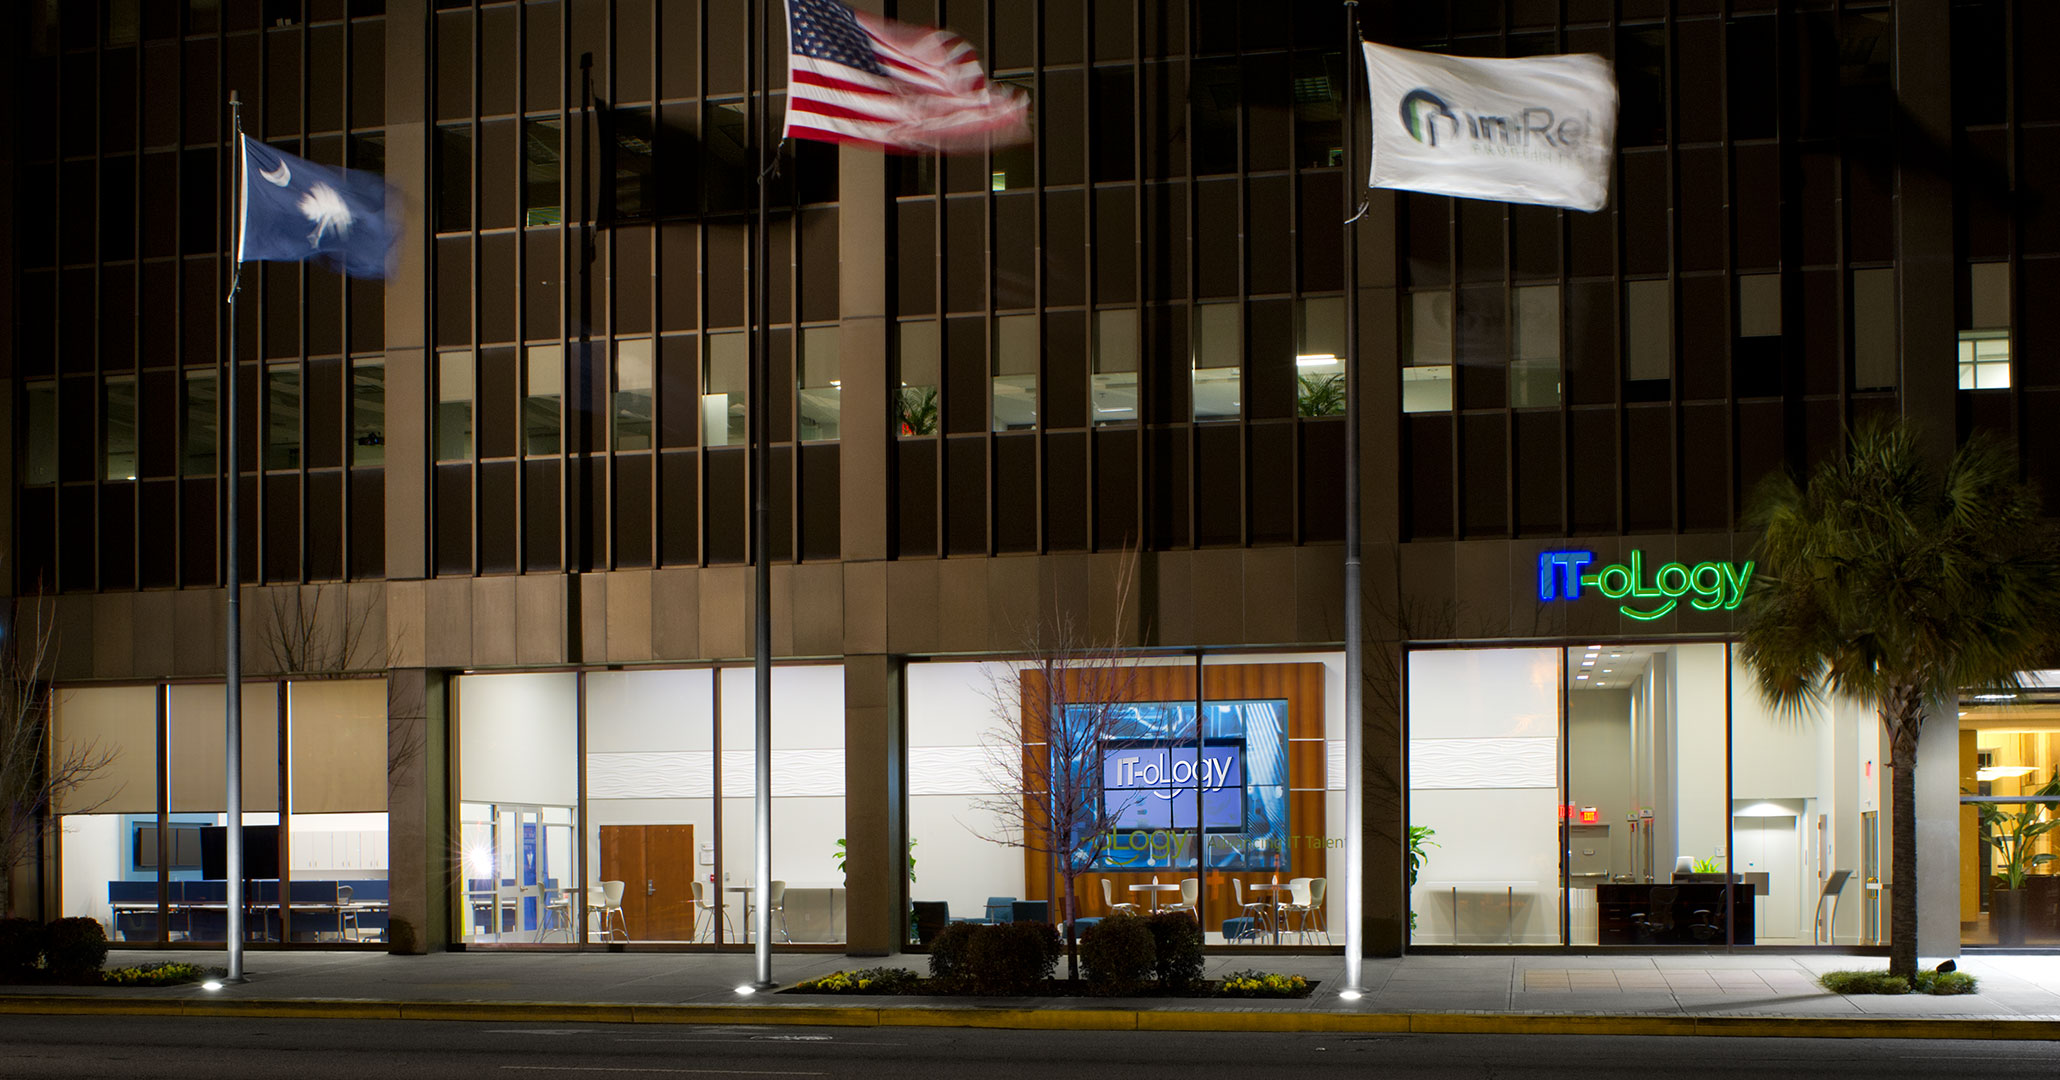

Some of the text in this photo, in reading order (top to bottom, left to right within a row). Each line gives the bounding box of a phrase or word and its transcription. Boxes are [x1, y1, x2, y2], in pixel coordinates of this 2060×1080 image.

[1539, 549, 1755, 612] IT-oLogy
[1117, 753, 1233, 794] IT-oLogy
[1287, 835, 1302, 849] IT
[1305, 834, 1346, 849] Talen
